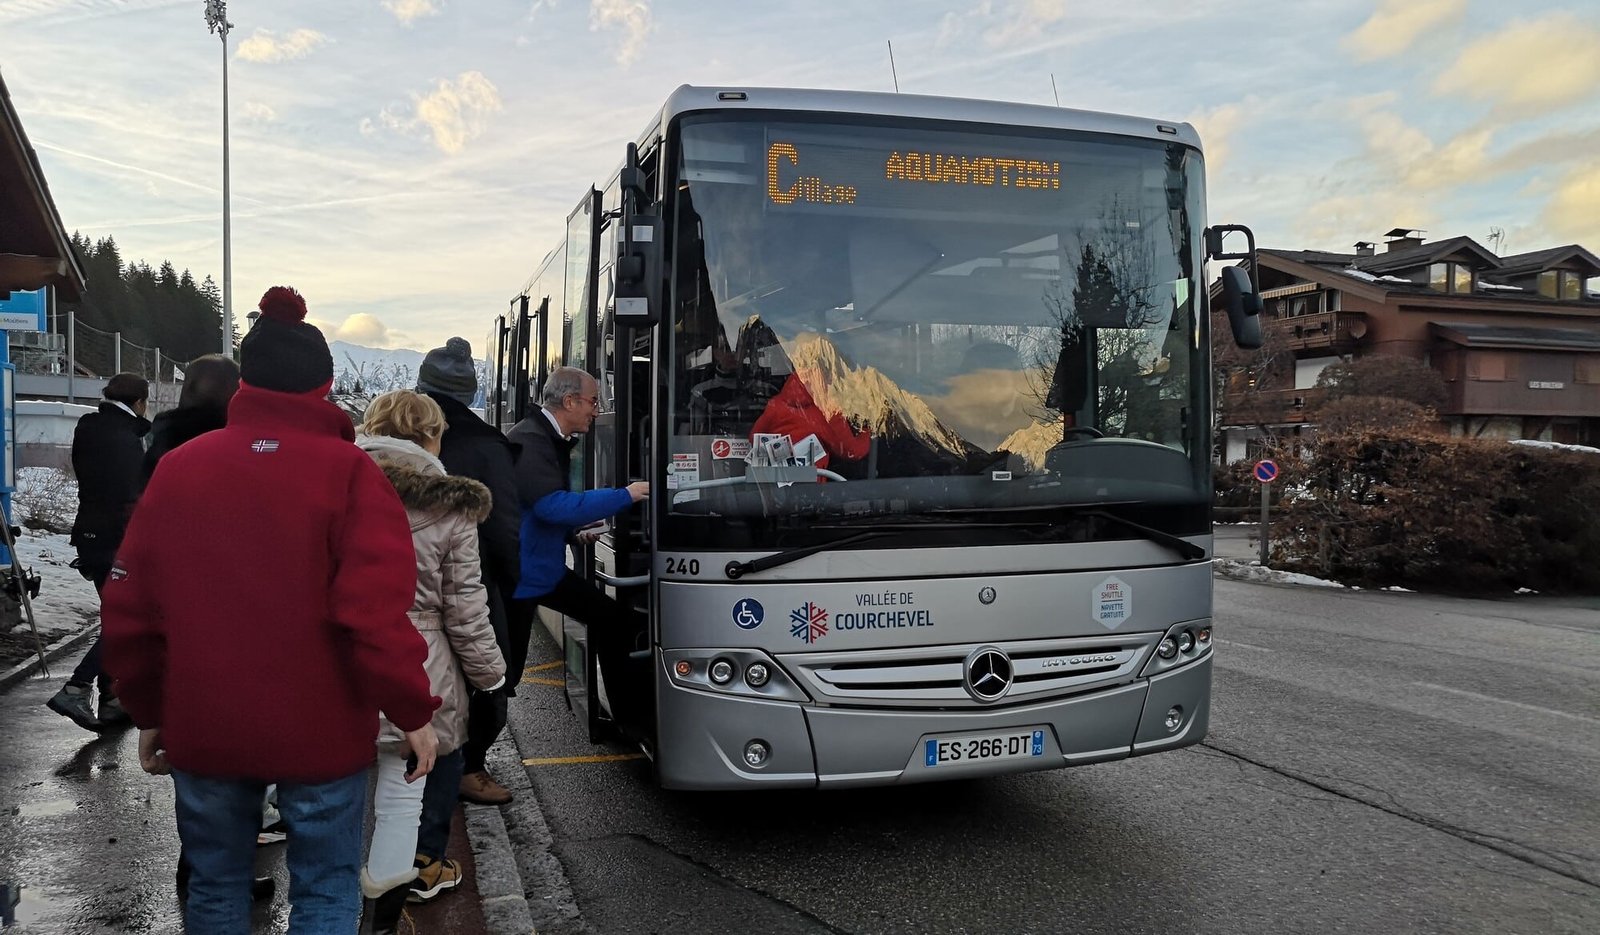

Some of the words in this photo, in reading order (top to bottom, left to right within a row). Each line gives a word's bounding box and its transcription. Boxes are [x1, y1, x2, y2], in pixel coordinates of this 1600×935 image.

[768, 143, 798, 204] C
[886, 151, 1061, 189] AQUAMOTION
[665, 557, 700, 576] 240
[1101, 591, 1124, 600] SHUTTLE
[1106, 583, 1119, 591] FREE
[855, 589, 897, 607] VALLÉE
[900, 592, 914, 605] DE
[1101, 603, 1124, 611] NAVETTE
[835, 610, 935, 631] COURCHEVEL
[1100, 611, 1124, 620] GRATUITE
[1041, 653, 1116, 668] INTOURO
[938, 735, 1031, 762] ES-266-DT
[1033, 744, 1042, 754] 73
